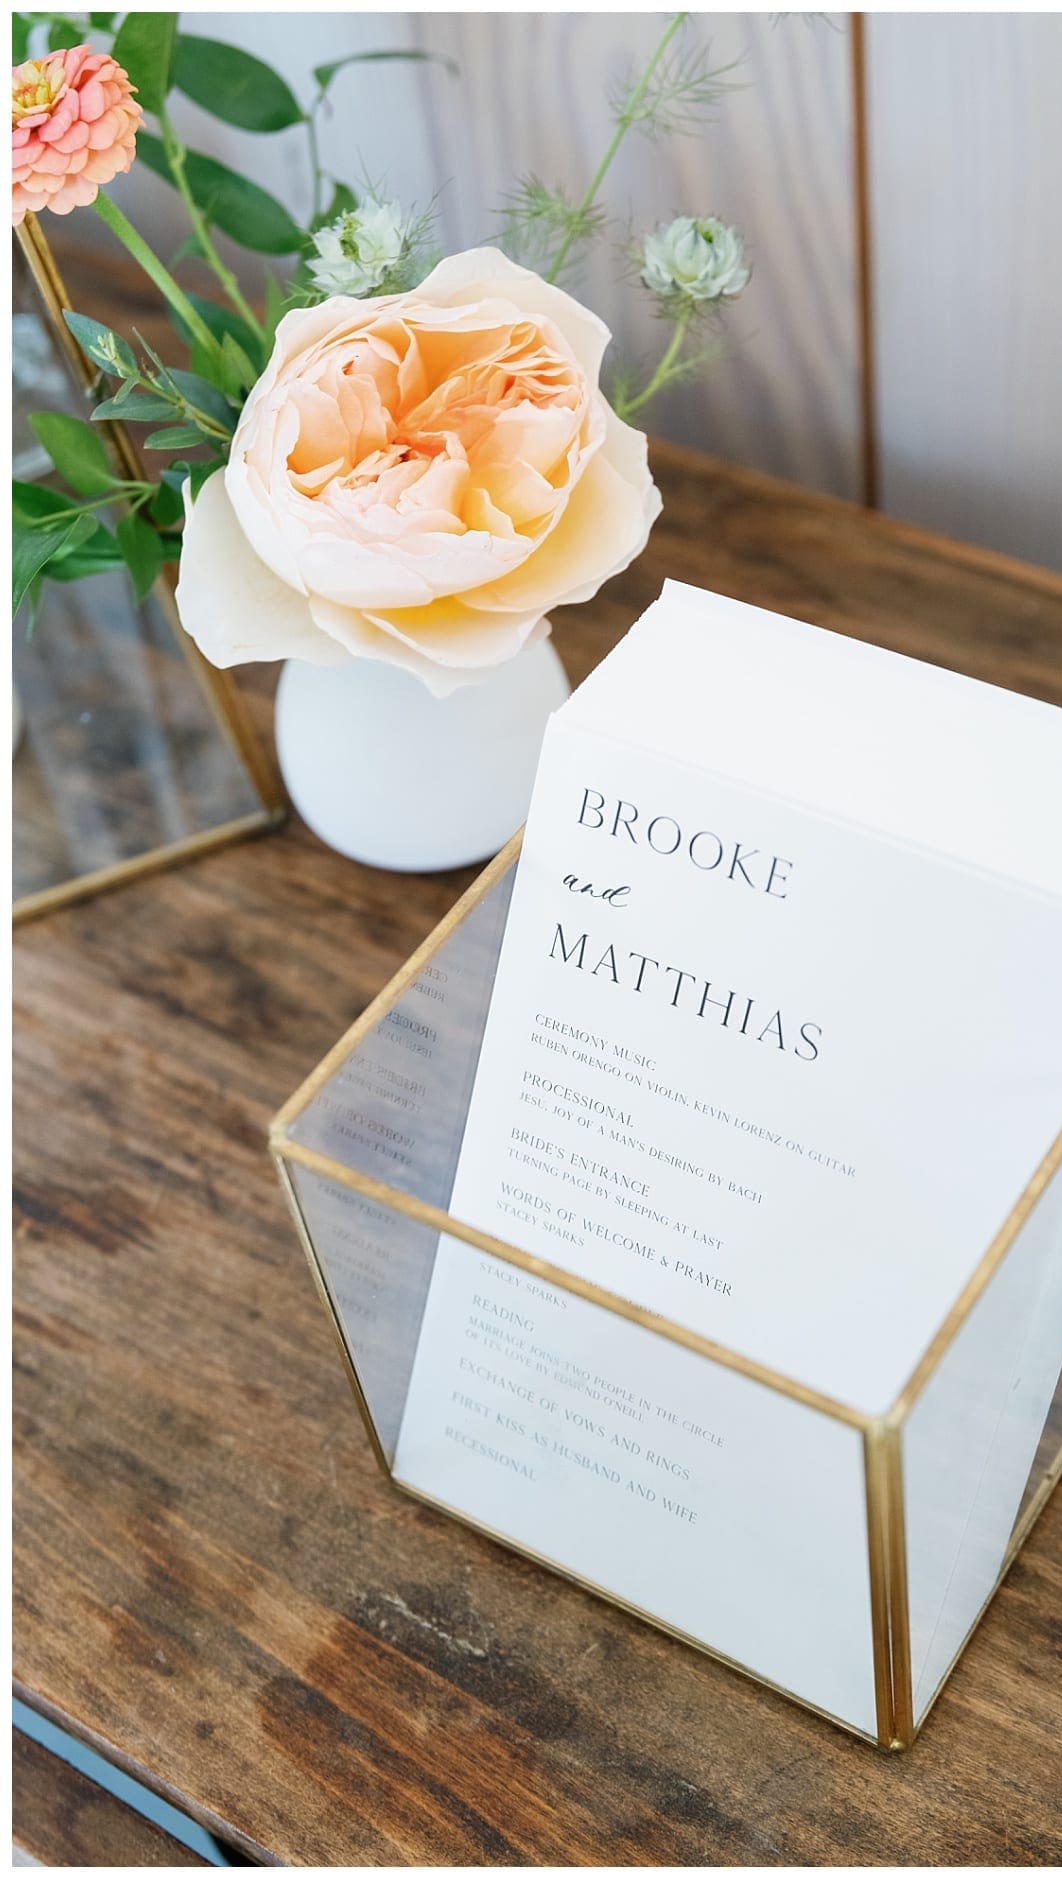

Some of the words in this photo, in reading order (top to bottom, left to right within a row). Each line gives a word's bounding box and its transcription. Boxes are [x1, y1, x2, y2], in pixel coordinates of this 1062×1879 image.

[562, 872, 632, 908] and
[577, 787, 794, 899] BROOKE
[548, 922, 823, 1062] MATTHIAS
[535, 1013, 609, 1051] CEREMONY
[613, 1045, 657, 1071] MUSIC
[522, 1071, 635, 1128] PROCESSIONAL
[530, 1032, 569, 1055] RUBEN
[572, 1050, 622, 1077] ORENGO
[625, 1072, 643, 1086] ON
[694, 1100, 730, 1124] KEVIN
[733, 1117, 783, 1146] LORENZ
[785, 1140, 805, 1156] ON
[808, 1150, 857, 1178] GUITAR
[507, 1147, 558, 1177] TURNING
[562, 1171, 592, 1192] PAGE
[595, 1185, 611, 1200] BY
[614, 1194, 669, 1226] SLEEPING
[673, 1222, 690, 1236] AT
[692, 1230, 724, 1251] LAST
[511, 1127, 566, 1159] BRIDE'S
[570, 1153, 651, 1198] ENTRANCE
[552, 1106, 574, 1121] JOY
[577, 1116, 594, 1129] OF
[598, 1125, 605, 1136] A
[609, 1130, 646, 1152] MAN'S
[648, 1146, 704, 1178] DESIRING
[708, 1172, 725, 1187] BY
[728, 1181, 762, 1204] BACH
[496, 1199, 539, 1226] STACEY
[542, 1220, 585, 1247] SPARKS
[500, 1181, 552, 1213] WORDS
[556, 1207, 576, 1223] OF
[582, 1218, 656, 1260] WELCOME
[660, 1255, 669, 1268] &
[675, 1260, 733, 1296] PRAYER
[472, 1294, 535, 1333] READING
[480, 1262, 522, 1287] STACEY
[526, 1284, 568, 1309] SPARKS
[459, 1357, 536, 1403] EXCHANGE
[540, 1397, 558, 1413] OF
[564, 1409, 606, 1438] VOWS
[610, 1433, 642, 1455] AND
[645, 1450, 691, 1481] RINGS
[465, 1328, 479, 1341] OF
[483, 1337, 502, 1352] ITS
[504, 1347, 532, 1368] LOVE
[535, 1361, 551, 1376] BY
[553, 1371, 601, 1401] EDMUND
[603, 1395, 645, 1424] O'NEILL
[468, 1315, 527, 1349] MARRIAGE
[530, 1345, 560, 1365] JOINS
[565, 1362, 591, 1380] TWO
[594, 1377, 635, 1403] PEOPLE
[638, 1397, 651, 1411] IN
[655, 1406, 679, 1425] THE
[682, 1420, 726, 1448] CIRCLE
[445, 1426, 537, 1482] RECESSIONAL
[452, 1391, 491, 1418] FIRST
[495, 1413, 526, 1436] KISS
[530, 1431, 549, 1448] AS
[551, 1442, 621, 1485] HUSBAND
[625, 1480, 656, 1502] AND
[662, 1497, 698, 1526] WIFE
